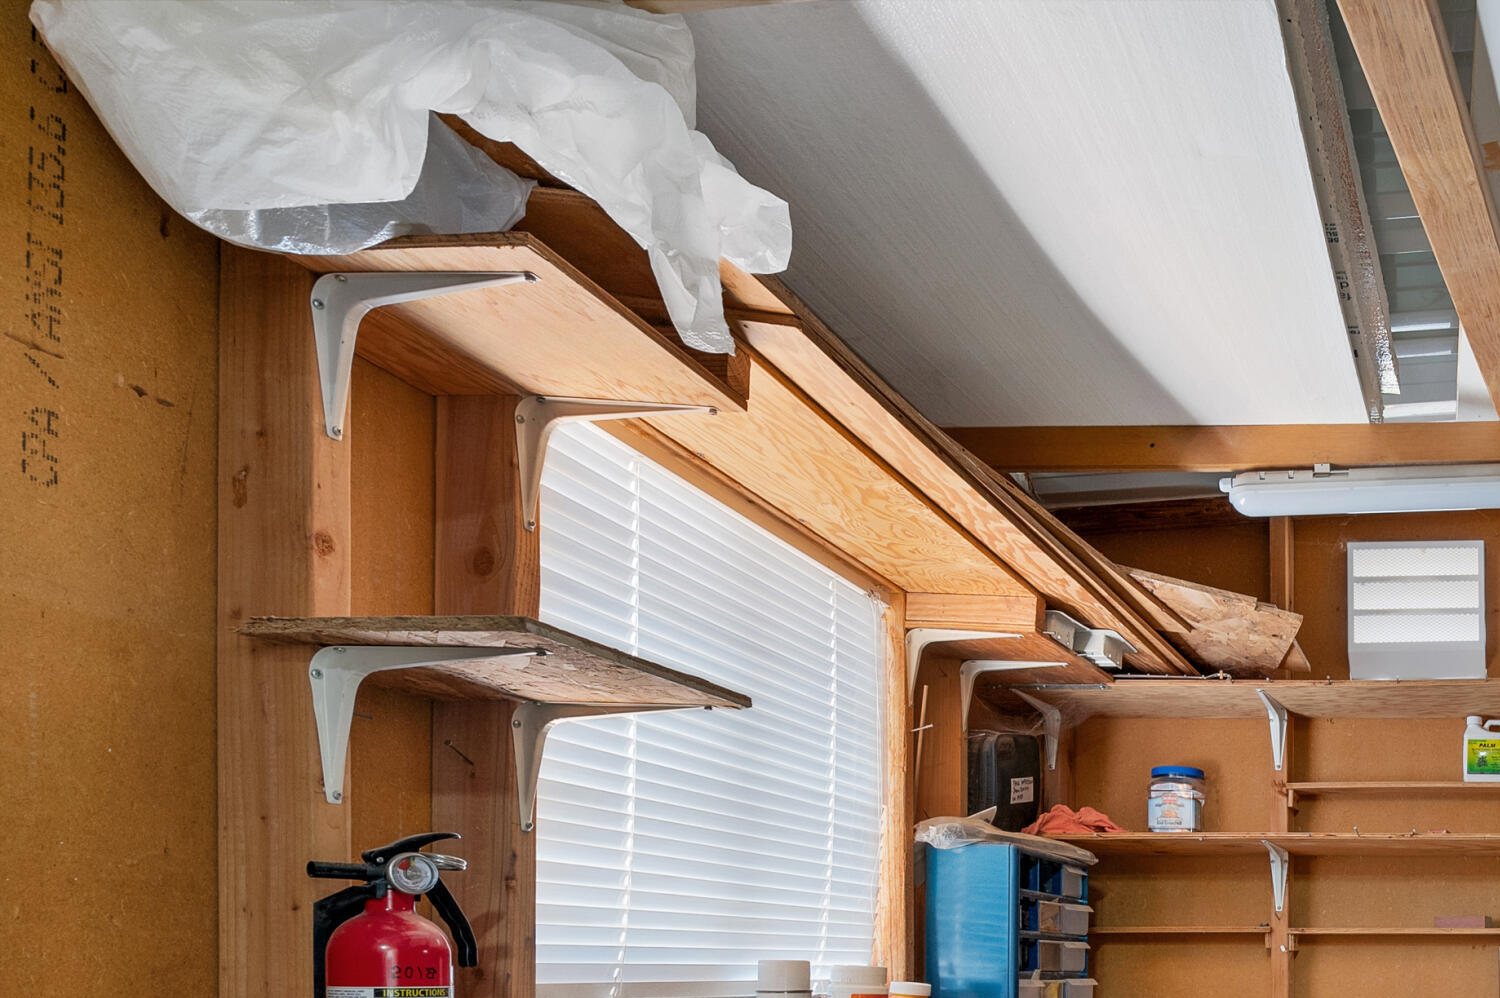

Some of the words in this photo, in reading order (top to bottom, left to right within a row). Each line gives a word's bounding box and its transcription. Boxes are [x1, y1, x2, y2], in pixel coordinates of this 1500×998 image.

[25, 231, 63, 343] ANSI
[21, 406, 59, 488] CPA
[382, 989, 446, 998] INSTRUCTIONS
